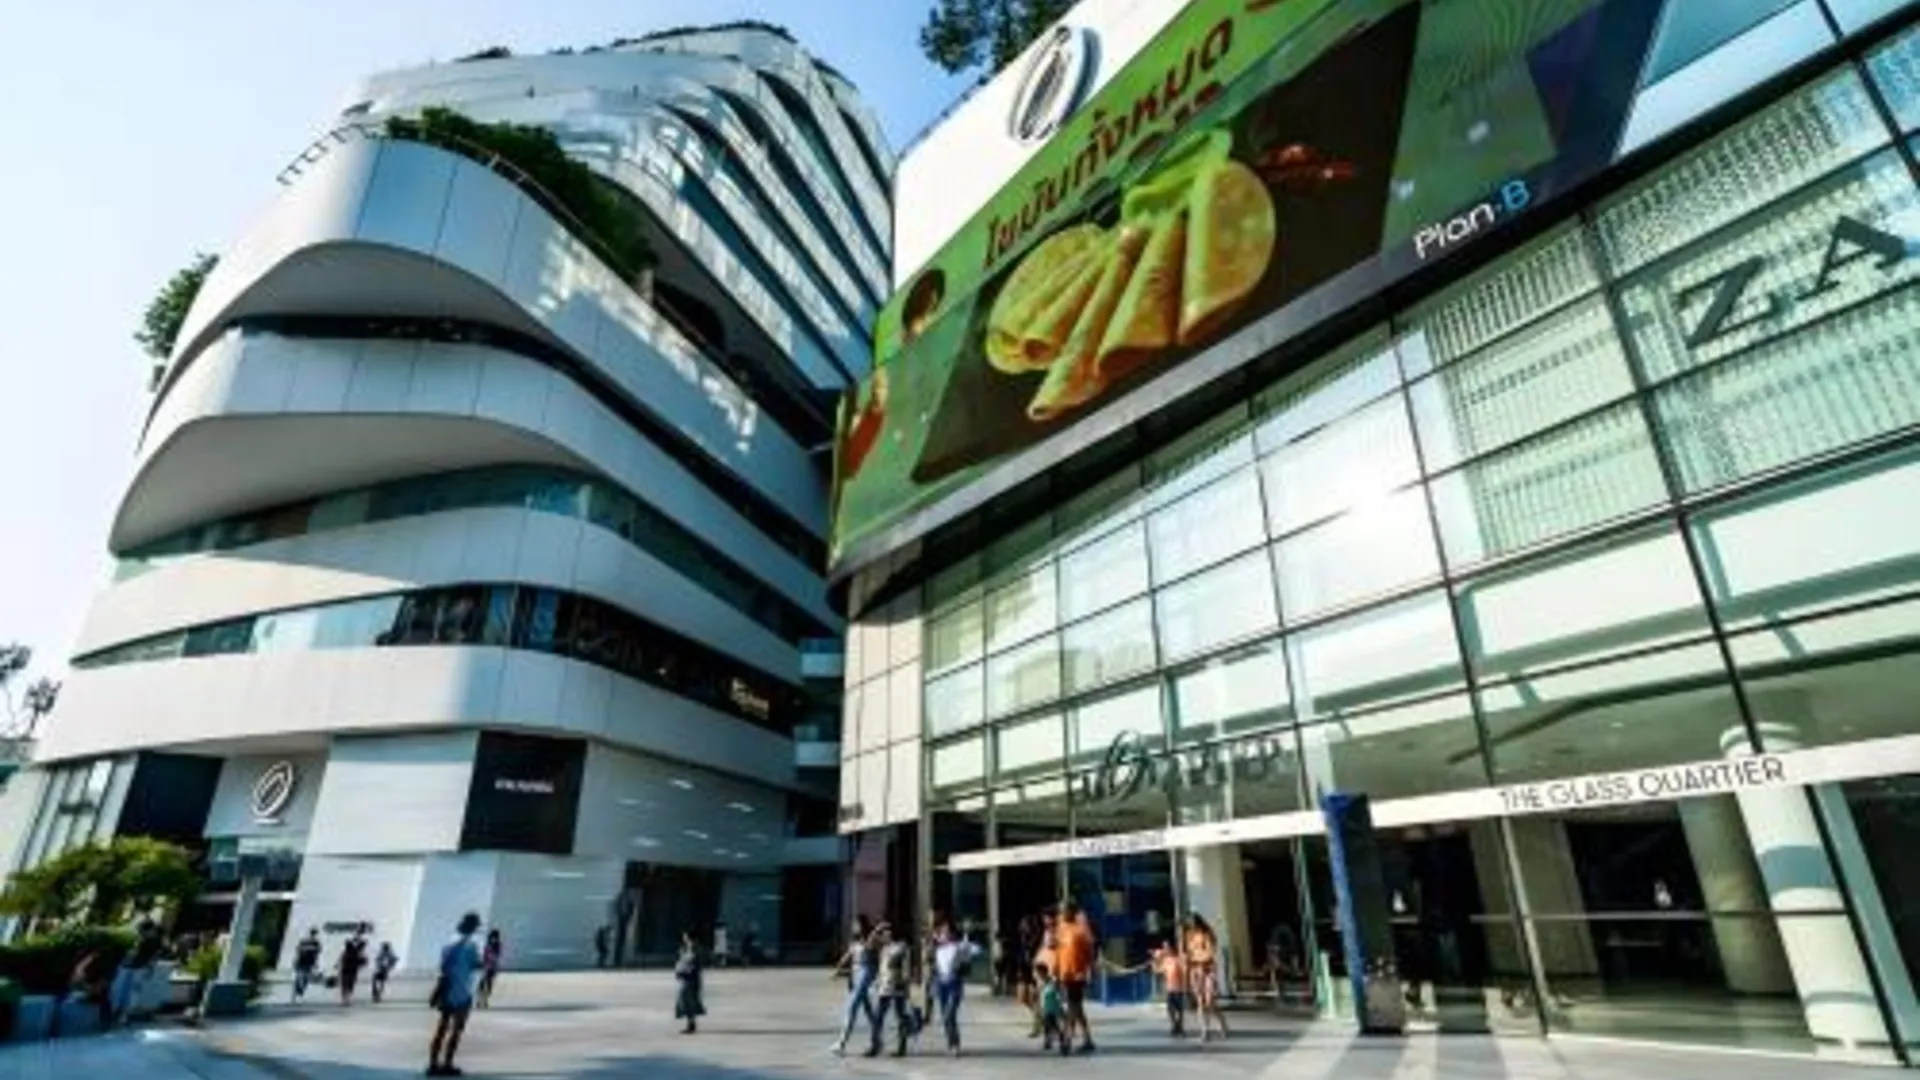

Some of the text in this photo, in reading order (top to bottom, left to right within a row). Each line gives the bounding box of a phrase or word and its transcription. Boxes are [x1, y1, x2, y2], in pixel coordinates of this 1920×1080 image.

[1675, 215, 1906, 349] ZA
[1499, 757, 1786, 810] THE GLASS QUARTIER
